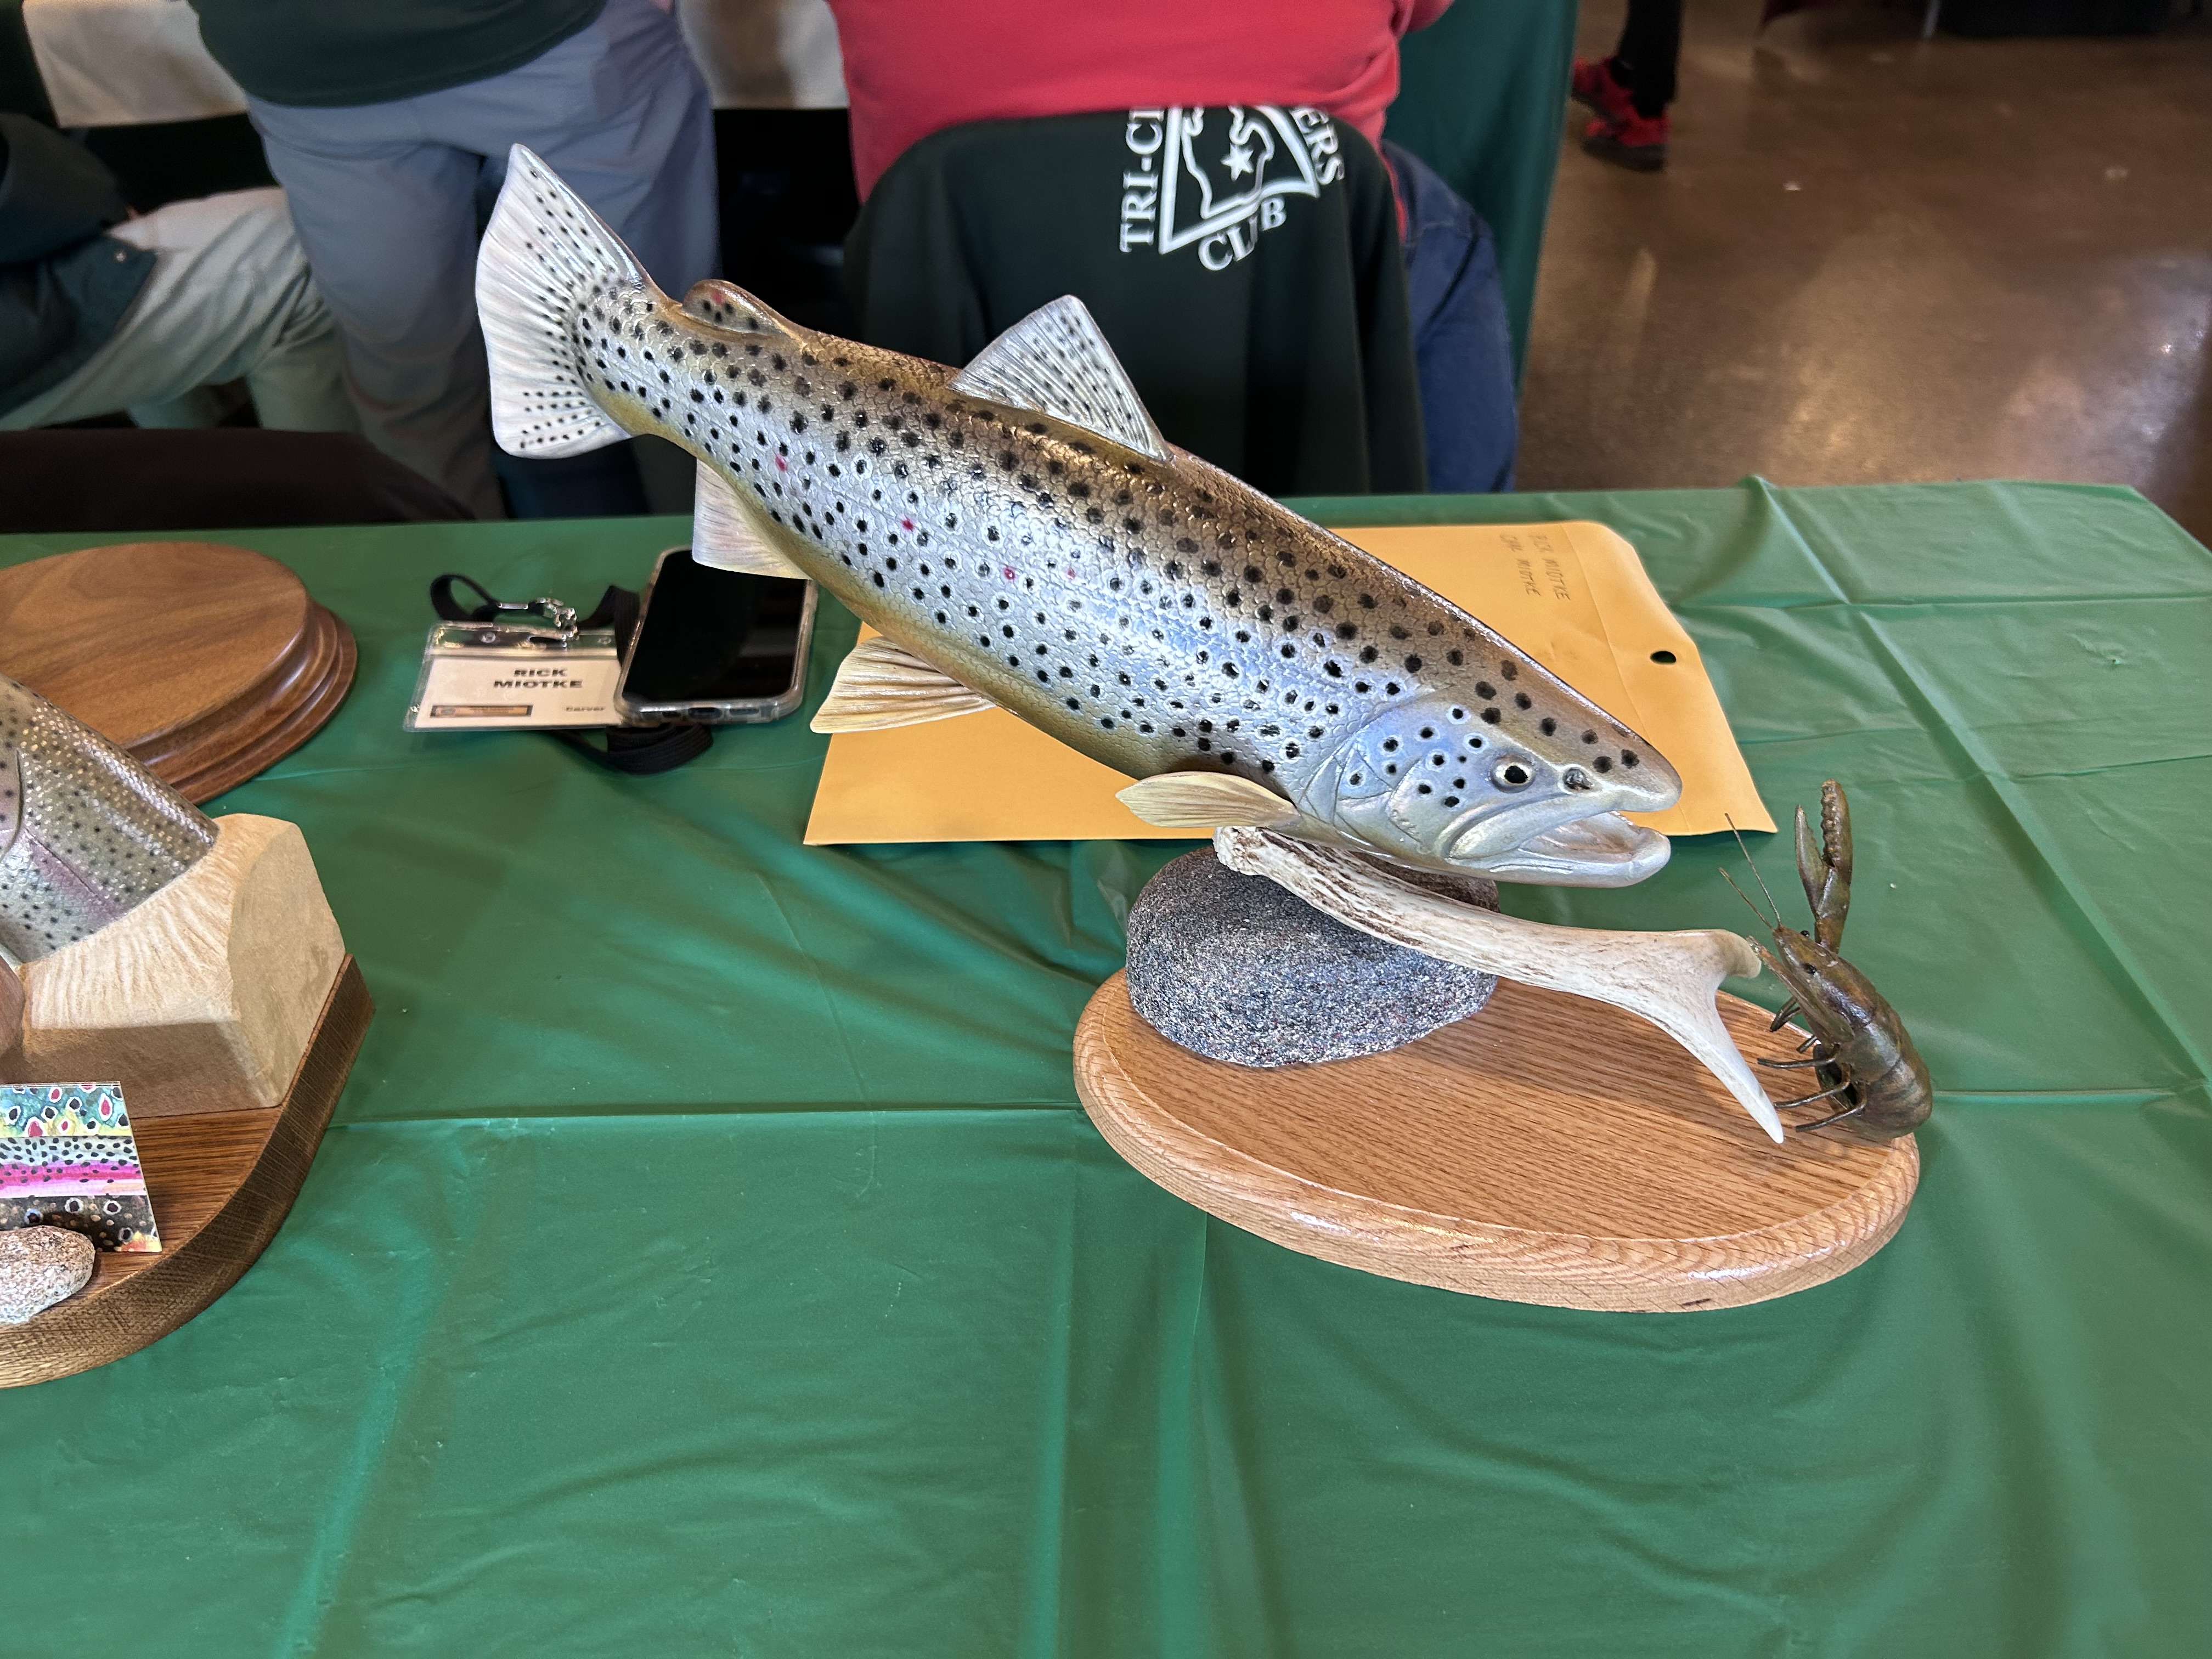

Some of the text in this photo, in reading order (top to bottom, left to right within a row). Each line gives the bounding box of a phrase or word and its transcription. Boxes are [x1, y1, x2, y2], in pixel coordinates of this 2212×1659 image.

[1120, 109, 1165, 253] TRI-CI
[1288, 106, 1345, 185] ERS
[1198, 195, 1287, 272] CLUB
[493, 680, 583, 689] MIOTKE
[514, 667, 568, 677] RICK
